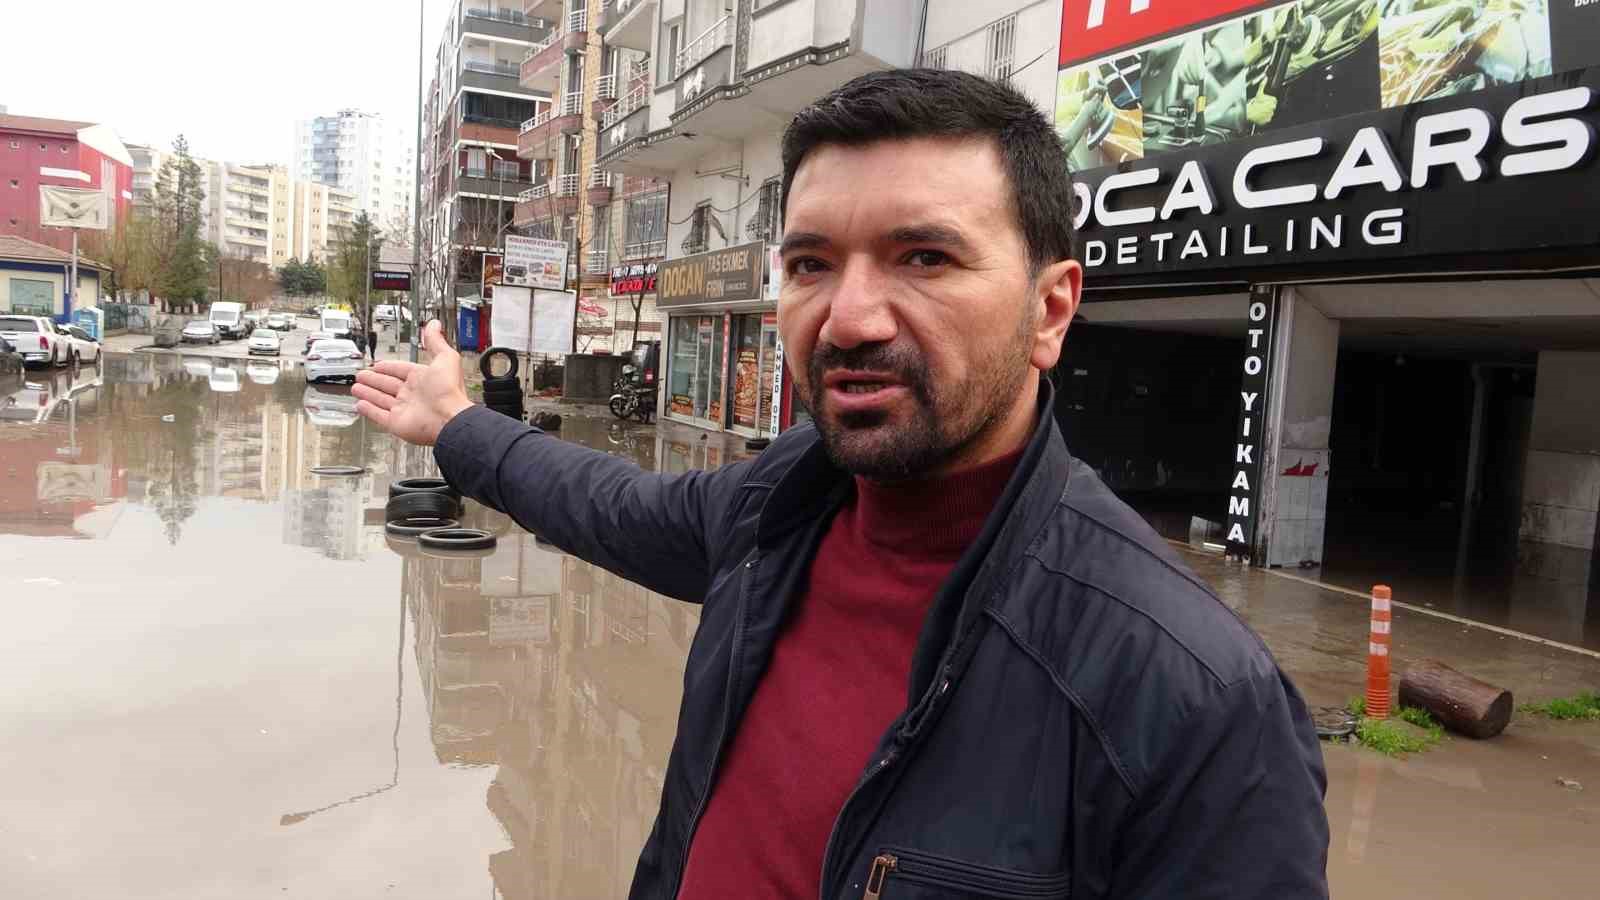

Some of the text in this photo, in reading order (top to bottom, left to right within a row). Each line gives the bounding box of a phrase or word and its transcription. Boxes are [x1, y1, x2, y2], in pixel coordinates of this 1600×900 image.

[1233, 86, 1592, 209] CARS
[1085, 208, 1404, 267] DETAILING
[770, 404, 779, 434] OTO
[1227, 302, 1266, 543] OTO YIKAMA
